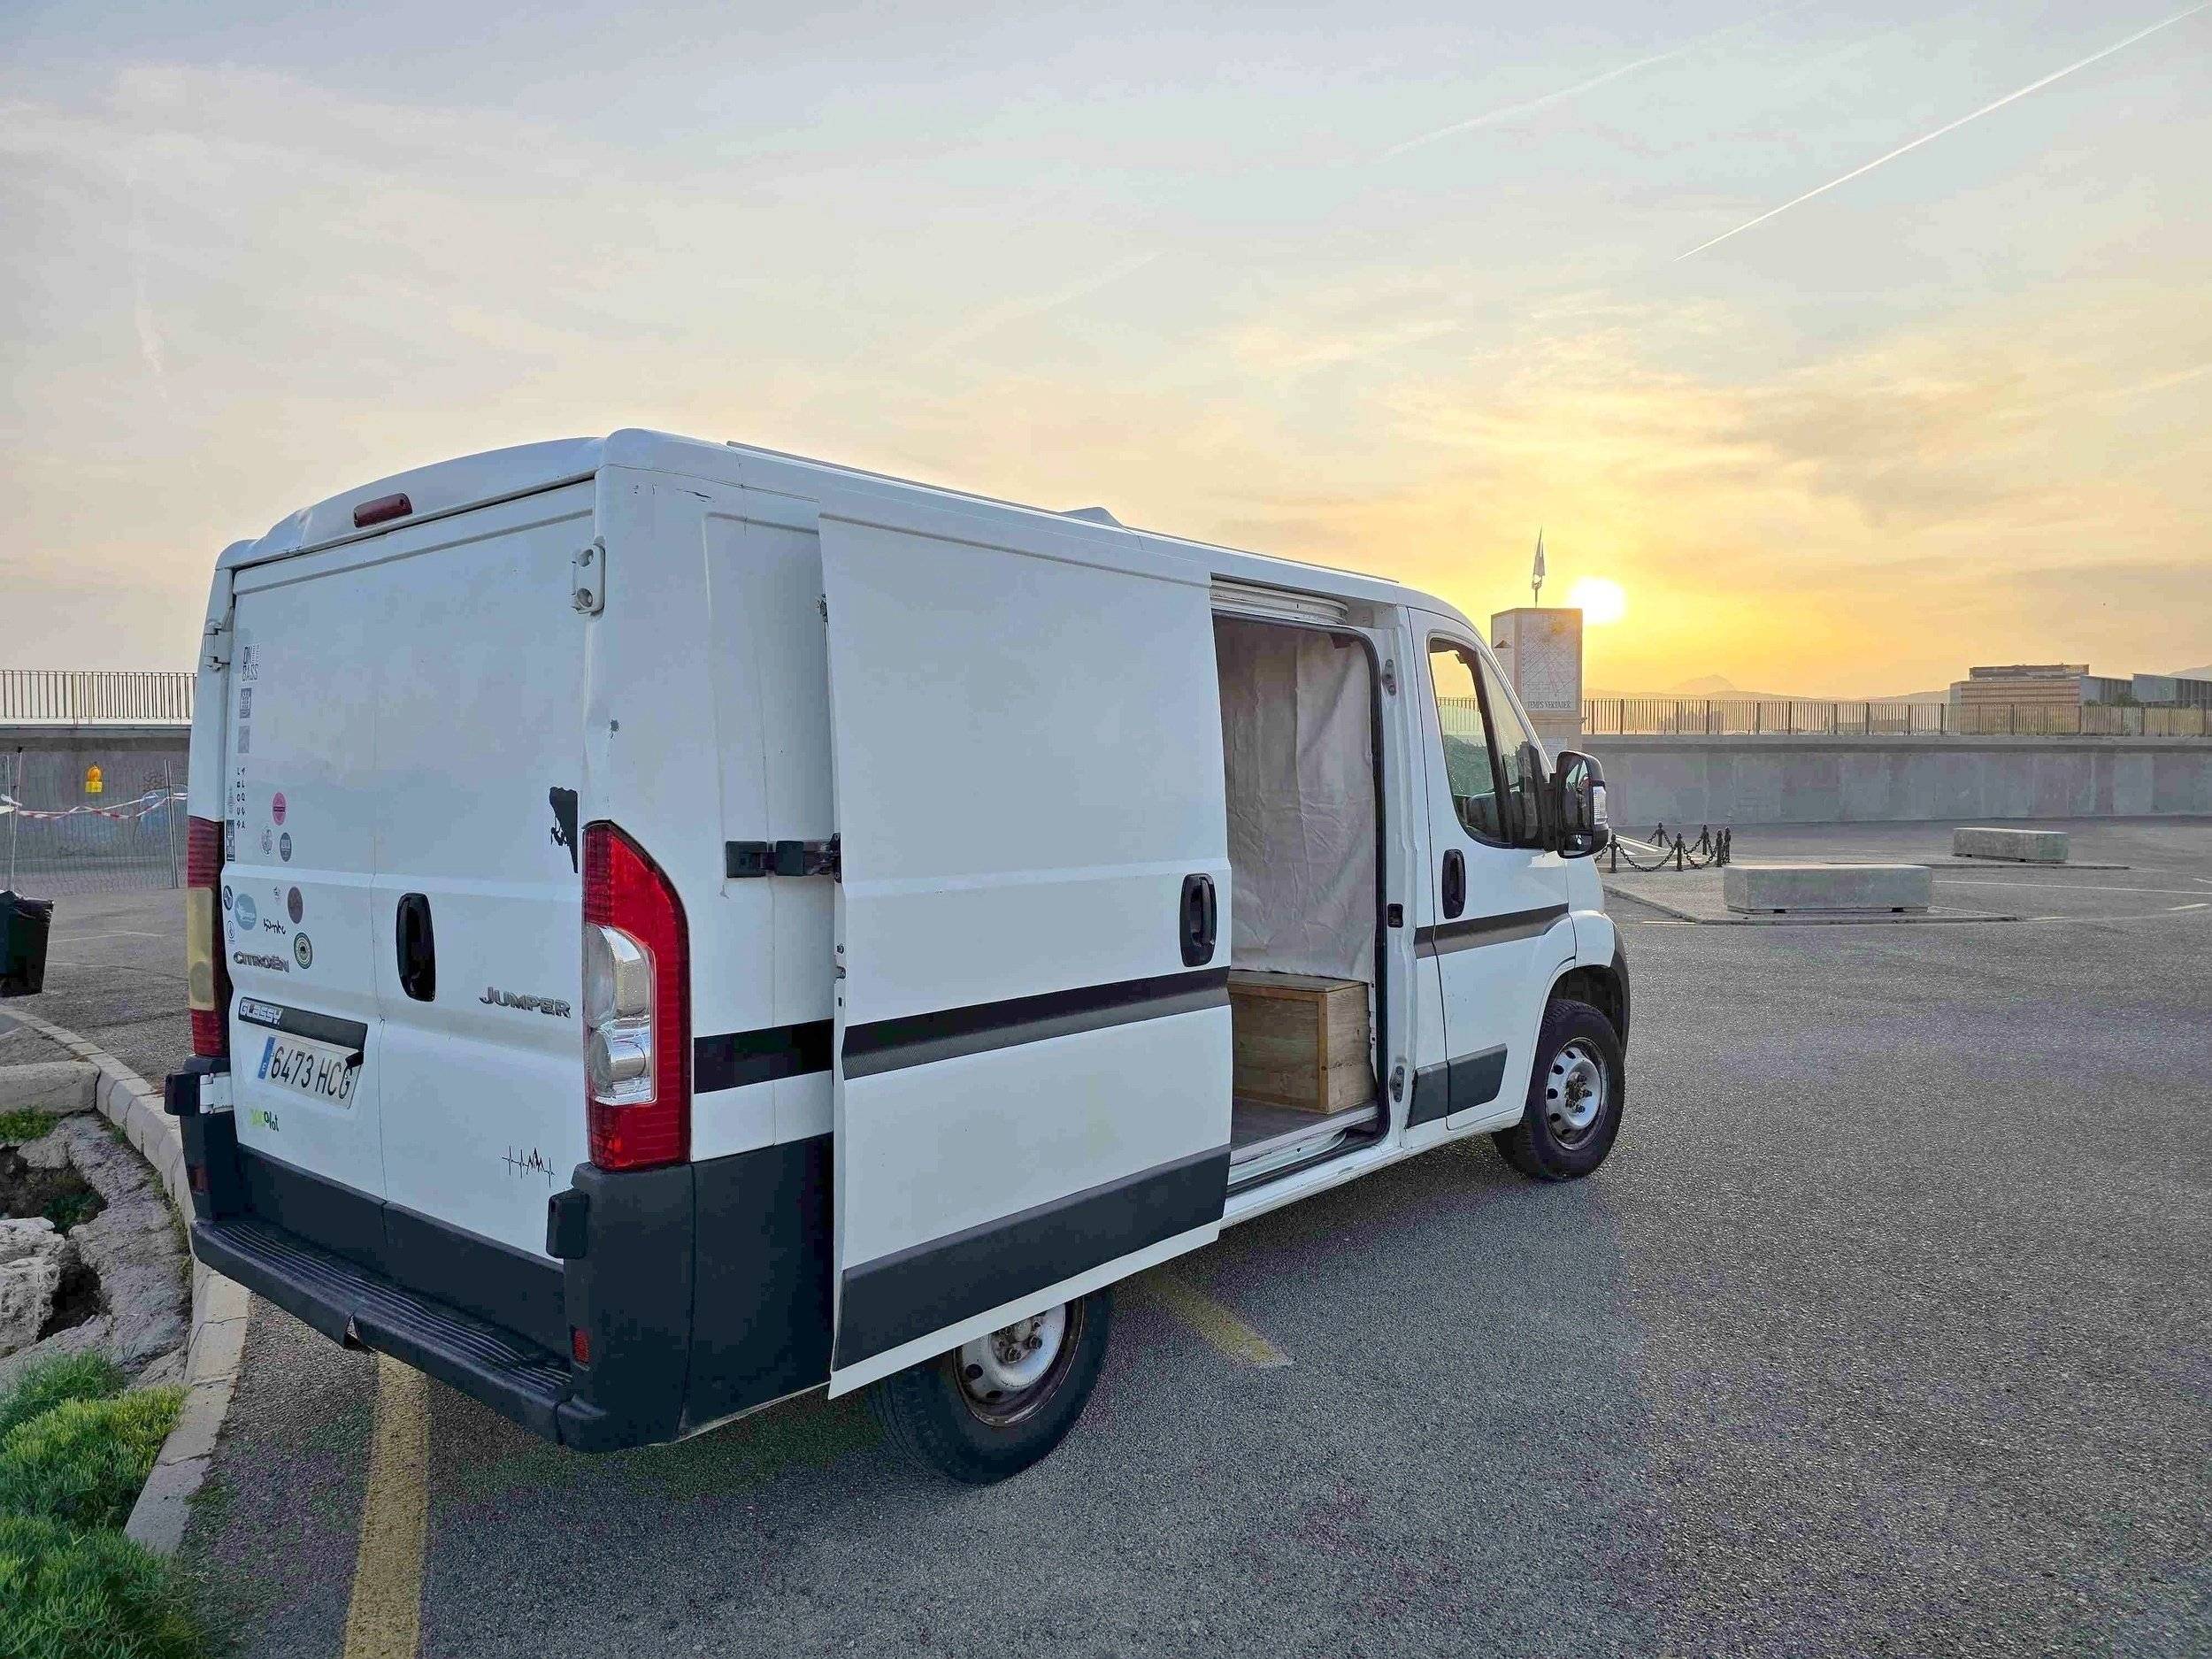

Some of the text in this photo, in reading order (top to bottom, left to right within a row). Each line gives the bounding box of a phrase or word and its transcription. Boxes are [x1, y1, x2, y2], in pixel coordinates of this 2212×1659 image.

[234, 950, 290, 973] CITROËN
[479, 986, 572, 1019] JUMPER
[271, 1046, 353, 1100] 6473 HCG
